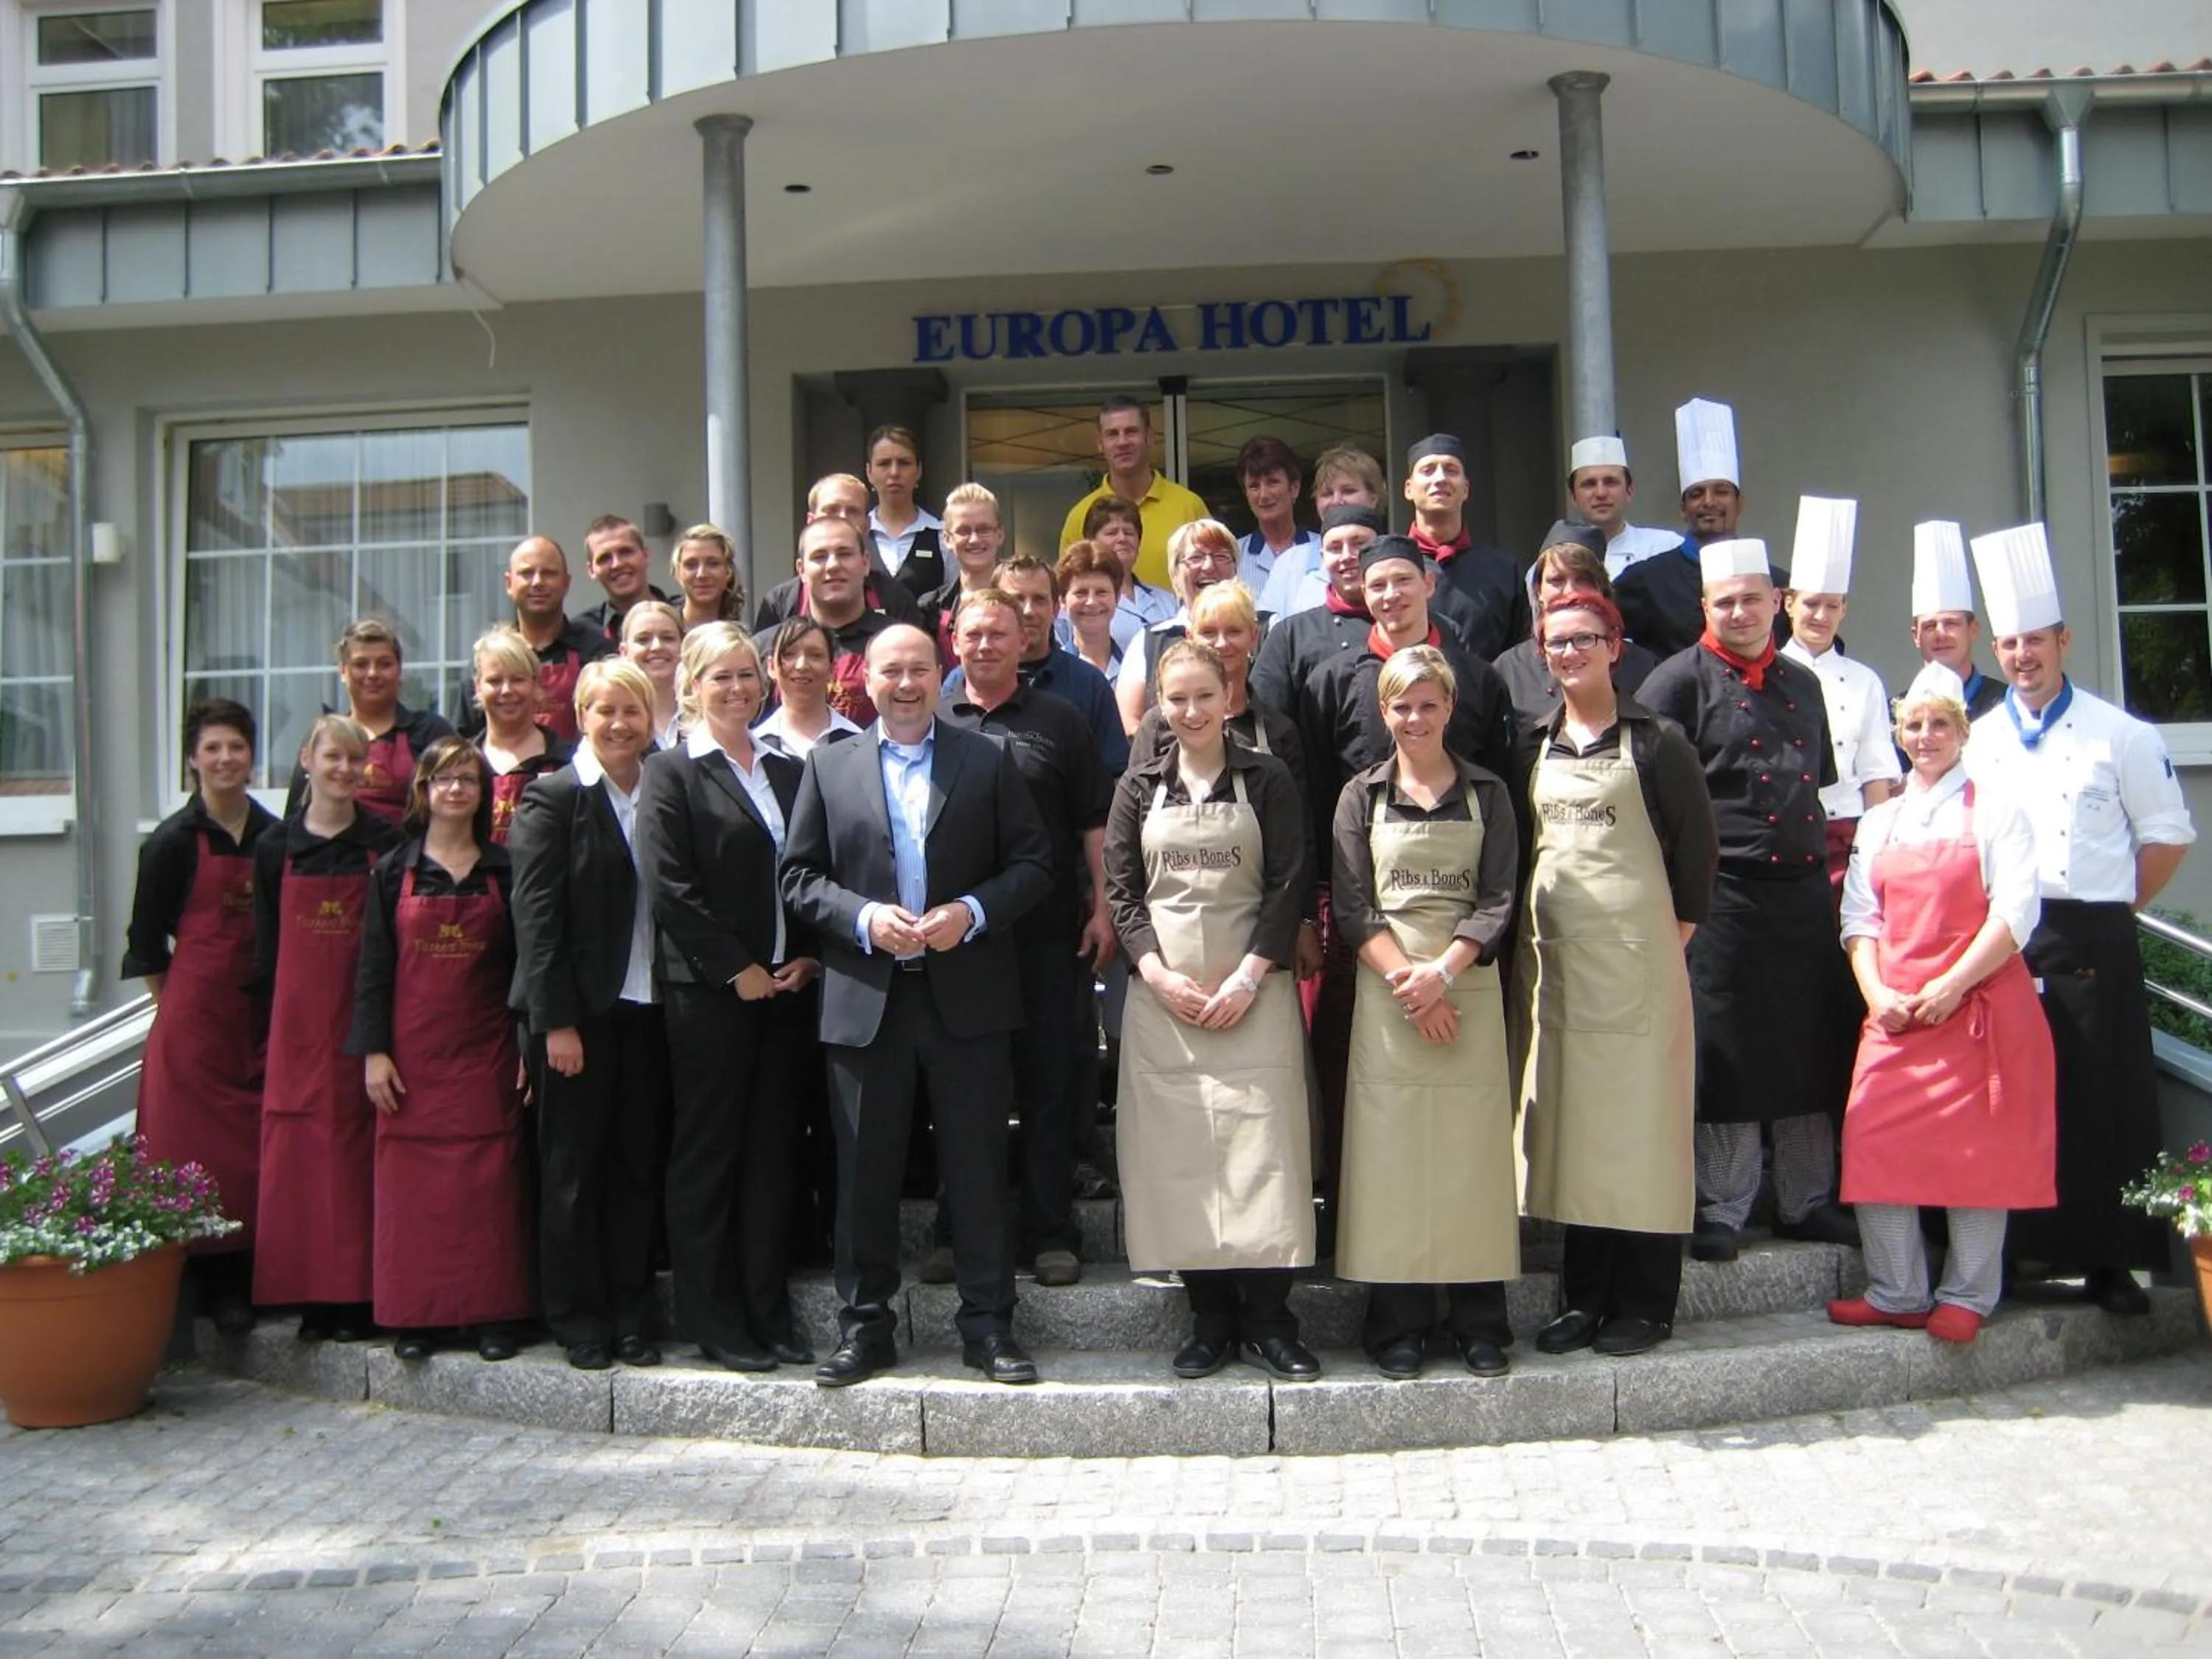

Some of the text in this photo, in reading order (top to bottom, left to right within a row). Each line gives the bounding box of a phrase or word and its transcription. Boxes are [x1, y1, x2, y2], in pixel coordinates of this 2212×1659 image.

[912, 295, 1432, 363] EUROPA HOTEL
[1162, 850, 1189, 872] Ribs
[1391, 869, 1421, 891] Ribs
